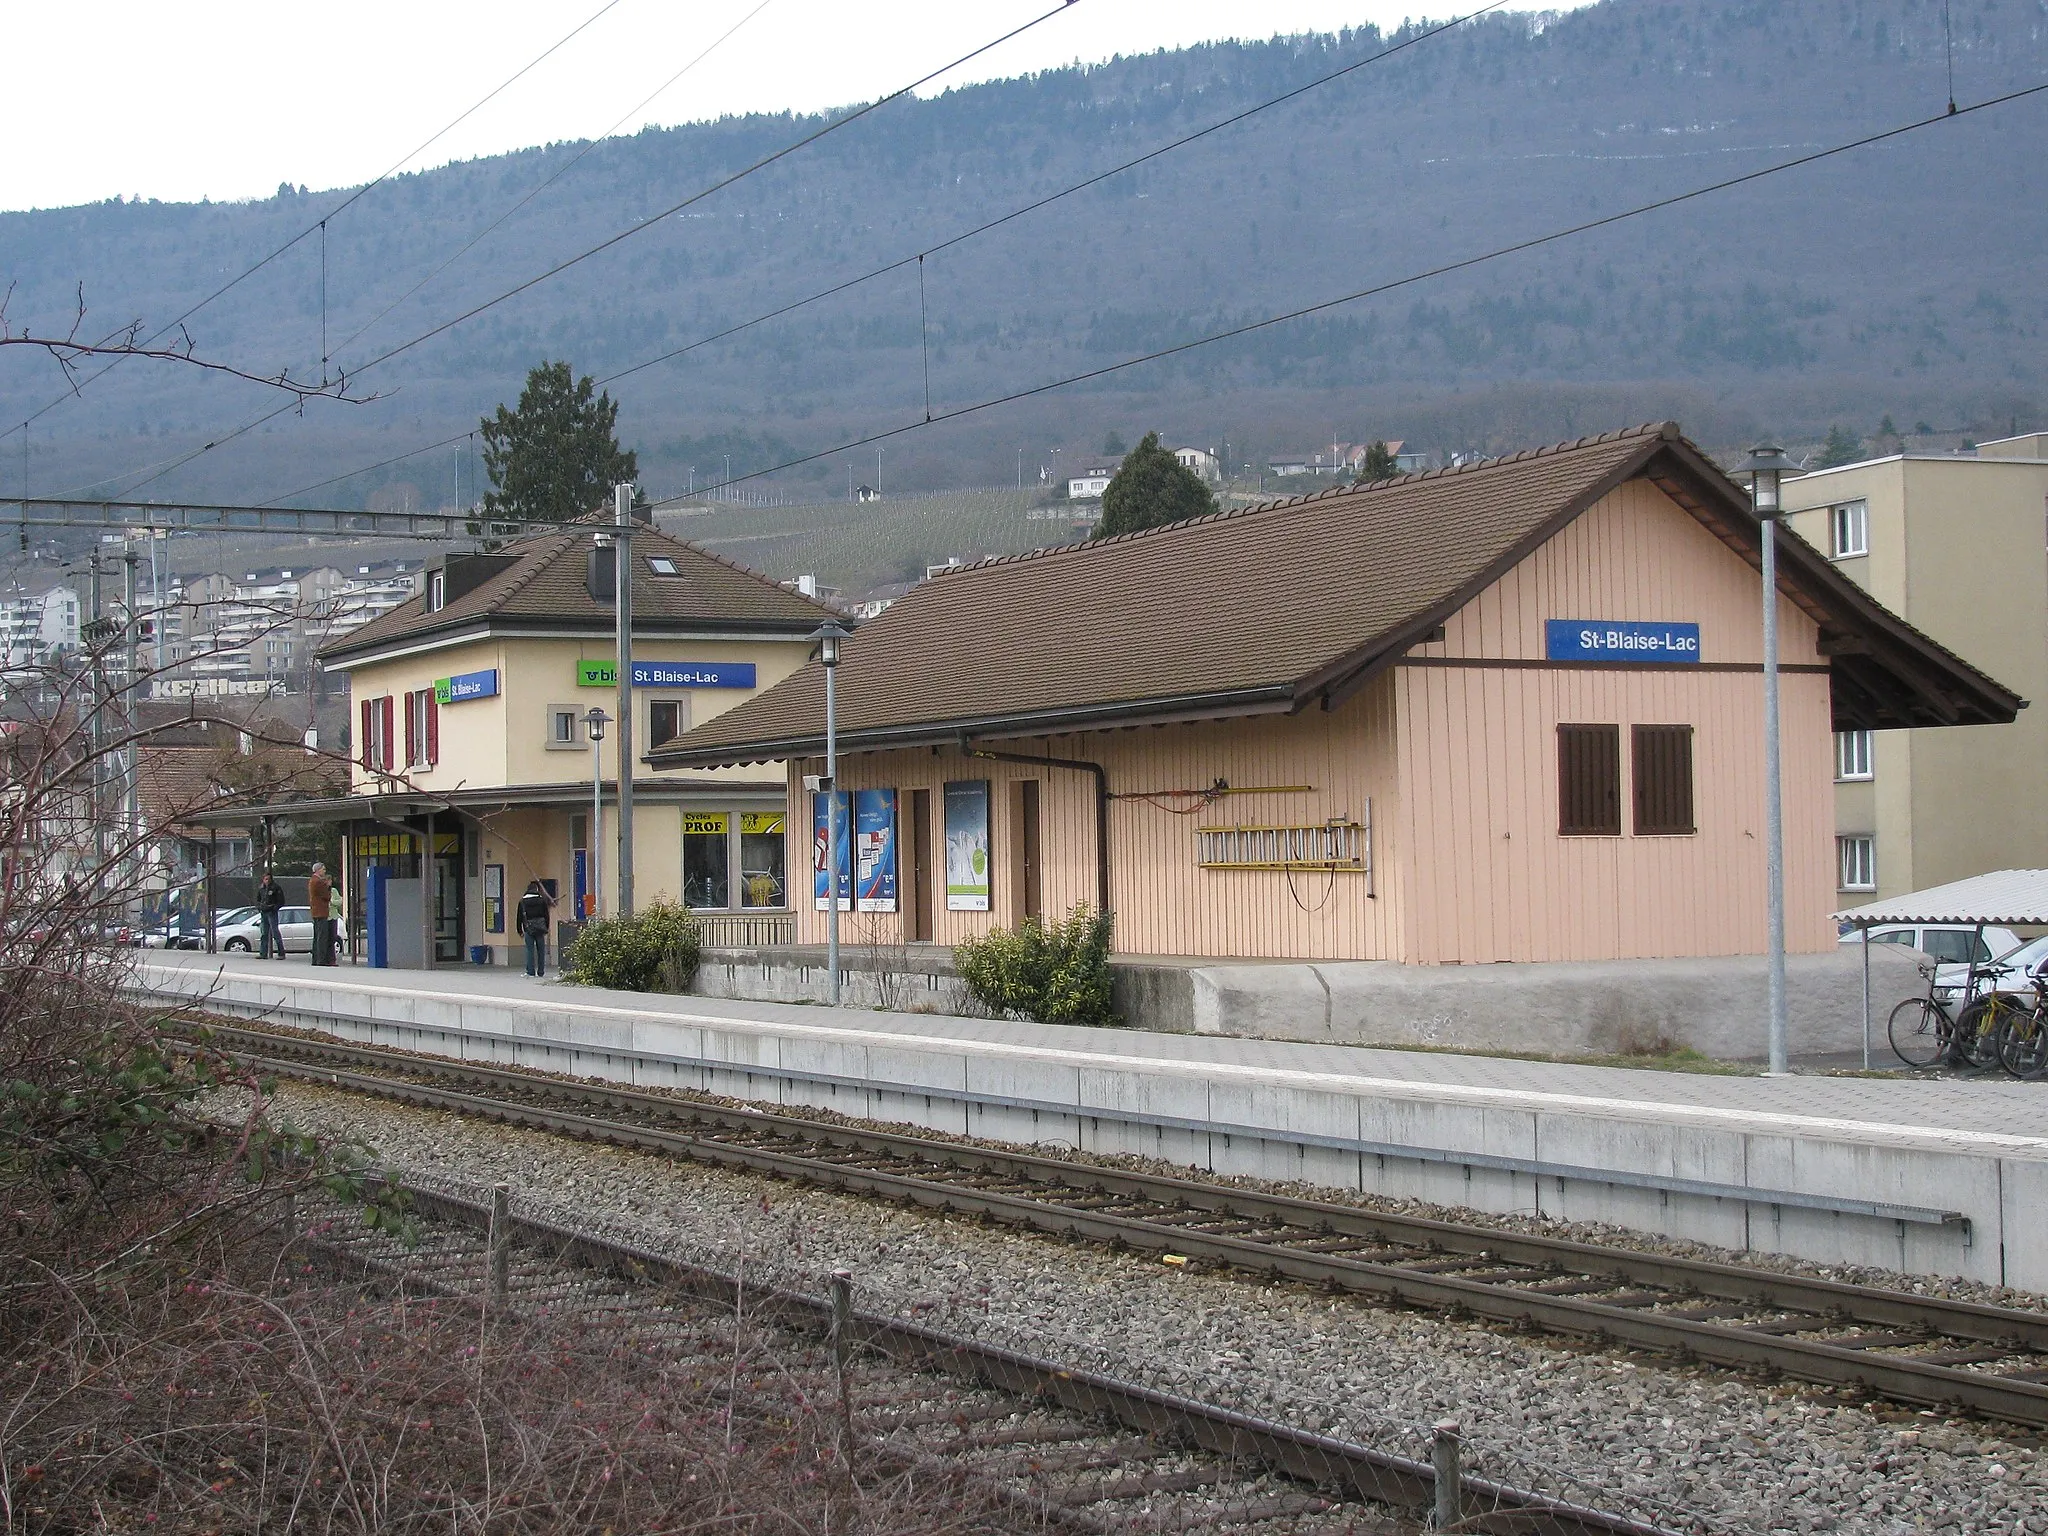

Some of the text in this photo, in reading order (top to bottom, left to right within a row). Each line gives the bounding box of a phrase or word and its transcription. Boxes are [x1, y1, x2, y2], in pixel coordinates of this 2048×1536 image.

[1579, 630, 1696, 650] St-Blaise-Lac
[634, 670, 651, 682] St.
[653, 671, 719, 683] Blaise-Lac
[457, 682, 481, 696] Blaise-Lac
[685, 813, 711, 821] Cycles
[684, 822, 723, 832] PROF
